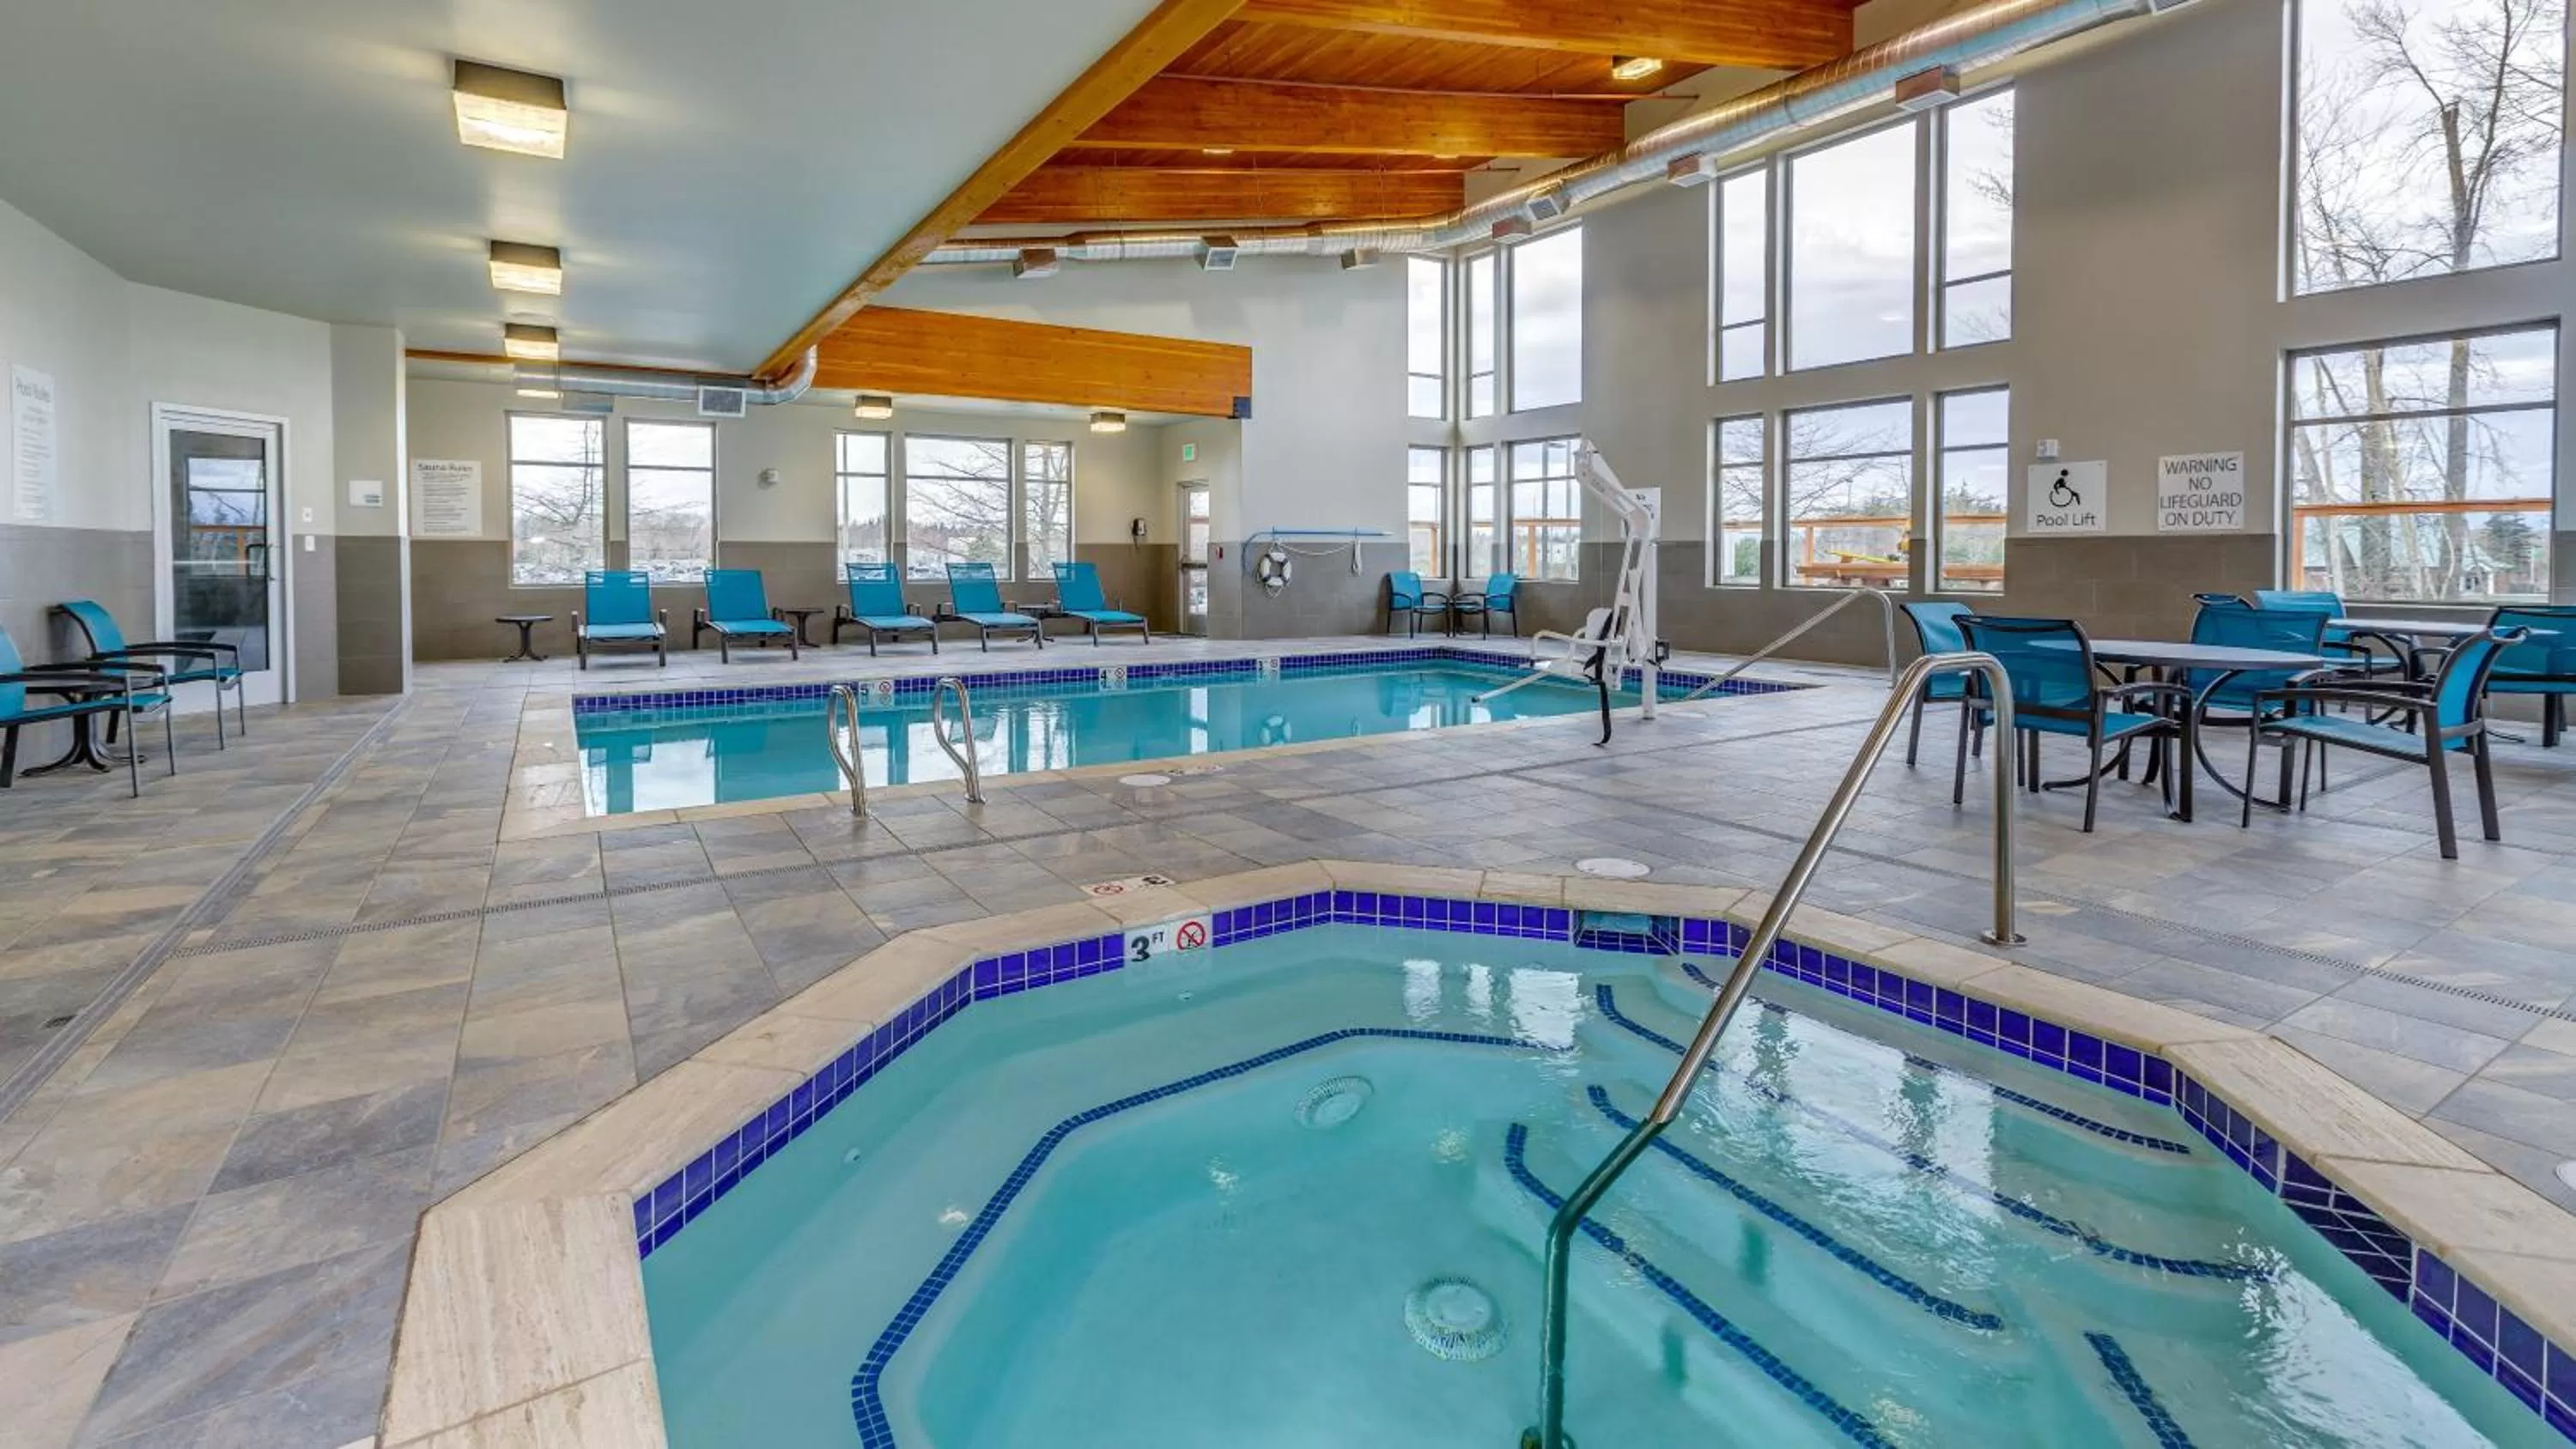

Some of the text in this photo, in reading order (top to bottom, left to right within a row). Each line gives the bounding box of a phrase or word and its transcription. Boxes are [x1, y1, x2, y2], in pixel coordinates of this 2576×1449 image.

[2165, 458, 2237, 475] WARNING
[2188, 477, 2212, 491] NO
[2160, 493, 2241, 509] LIFEGUARD
[2036, 512, 2096, 526] Pool Lift
[2165, 511, 2234, 526] ON DUTY
[1101, 669, 1107, 680] 4
[1132, 932, 1164, 961] 3 FT
